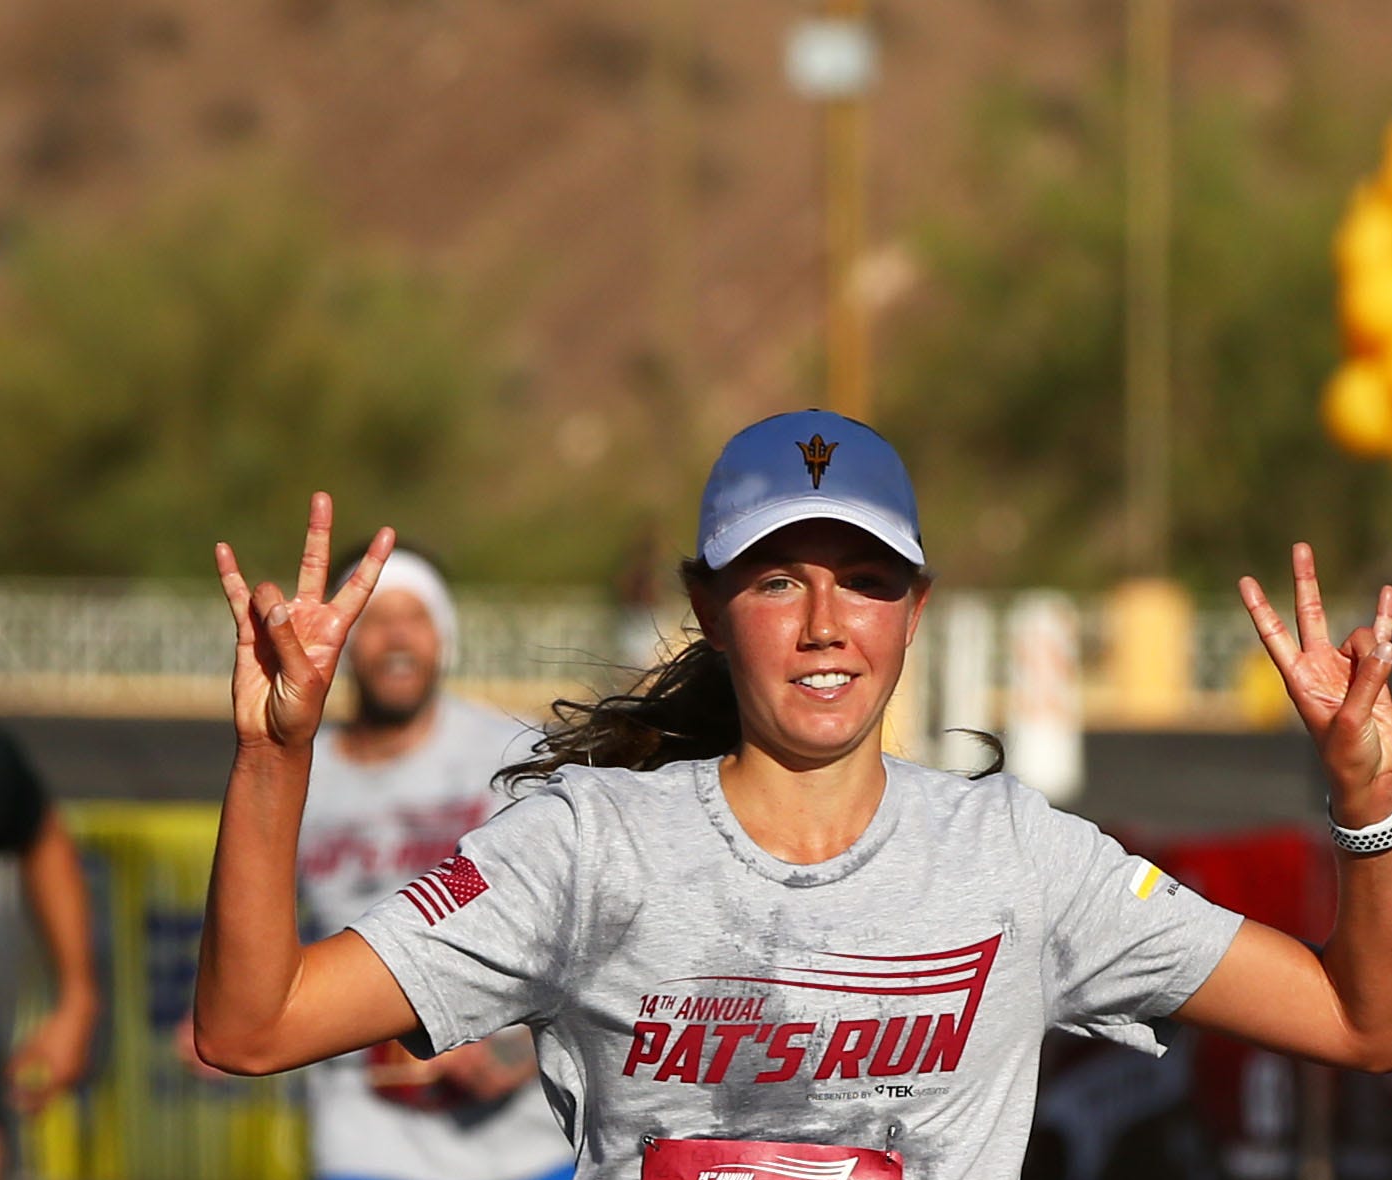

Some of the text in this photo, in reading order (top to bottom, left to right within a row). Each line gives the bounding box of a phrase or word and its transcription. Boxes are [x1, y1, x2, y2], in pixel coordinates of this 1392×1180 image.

[638, 994, 766, 1021] 14TH ANNUAL
[622, 987, 983, 1084] PAT'S RUN
[806, 1091, 859, 1101] PRESENTED
[861, 1091, 872, 1099] BY
